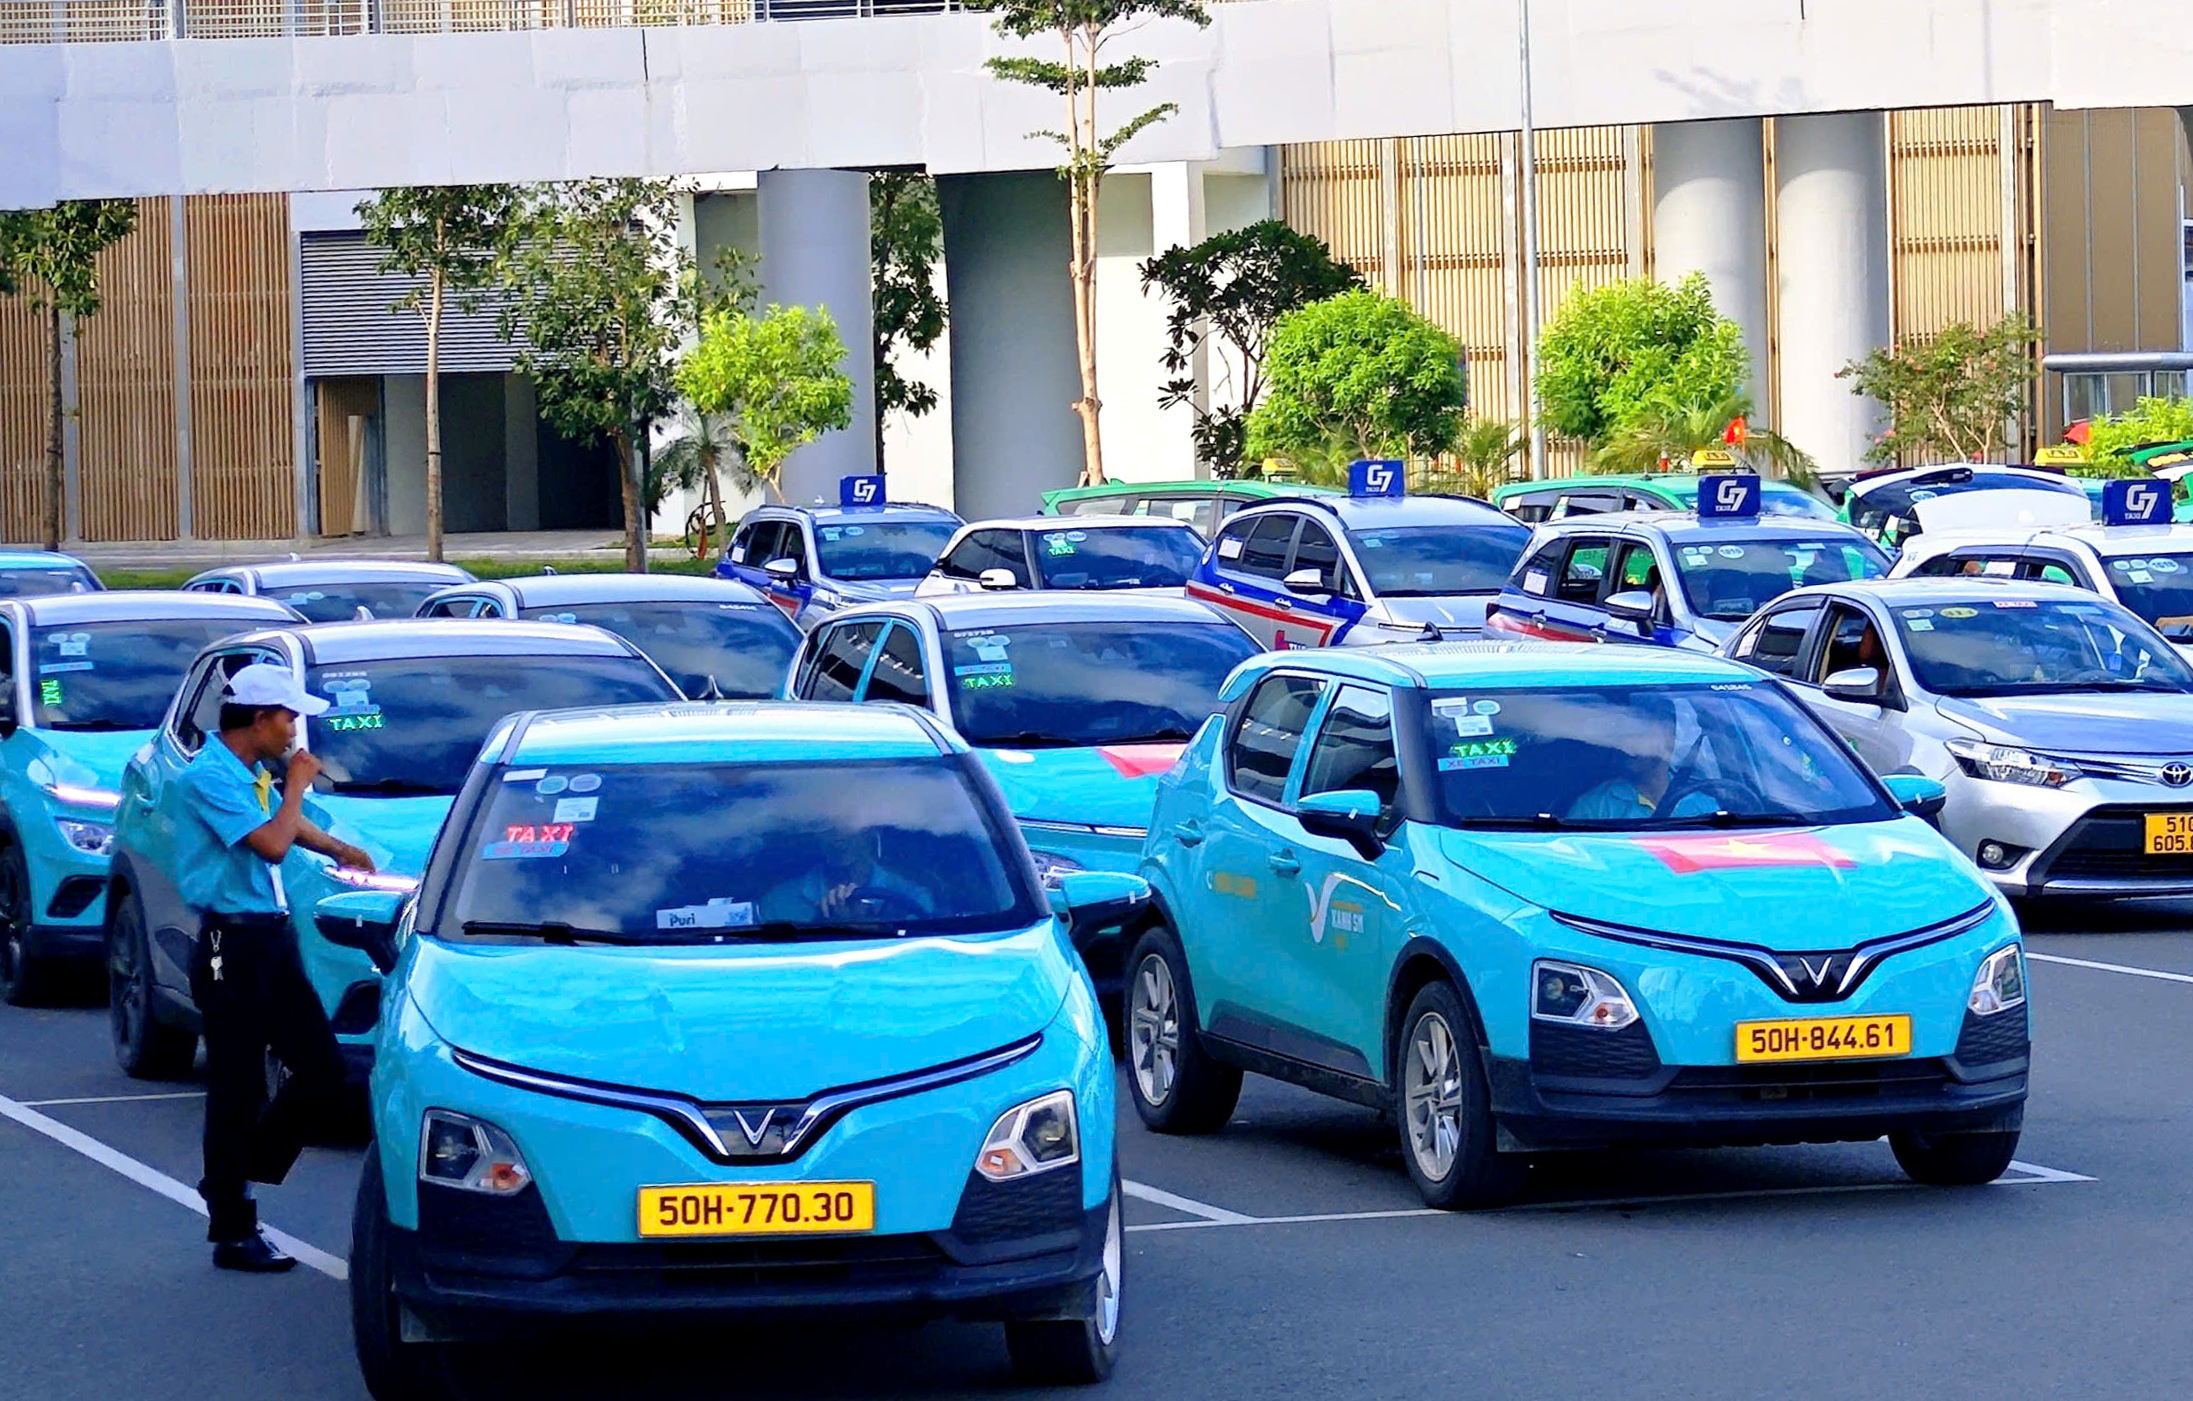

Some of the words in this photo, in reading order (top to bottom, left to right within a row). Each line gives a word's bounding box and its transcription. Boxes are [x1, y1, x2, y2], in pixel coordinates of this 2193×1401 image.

[1367, 464, 1394, 493] G7
[853, 478, 877, 503] G7
[1716, 479, 1748, 512] G7
[2126, 484, 2158, 519] G7
[964, 673, 1014, 689] TAXI
[328, 714, 384, 732] TAXI
[1453, 739, 1517, 758] TAXI
[1470, 757, 1501, 767] TAXI
[507, 824, 575, 843] TAXI
[2153, 834, 2193, 852] 605.
[1751, 1022, 1895, 1054] 50H-844.61
[658, 1191, 854, 1226] 50H-770.30
